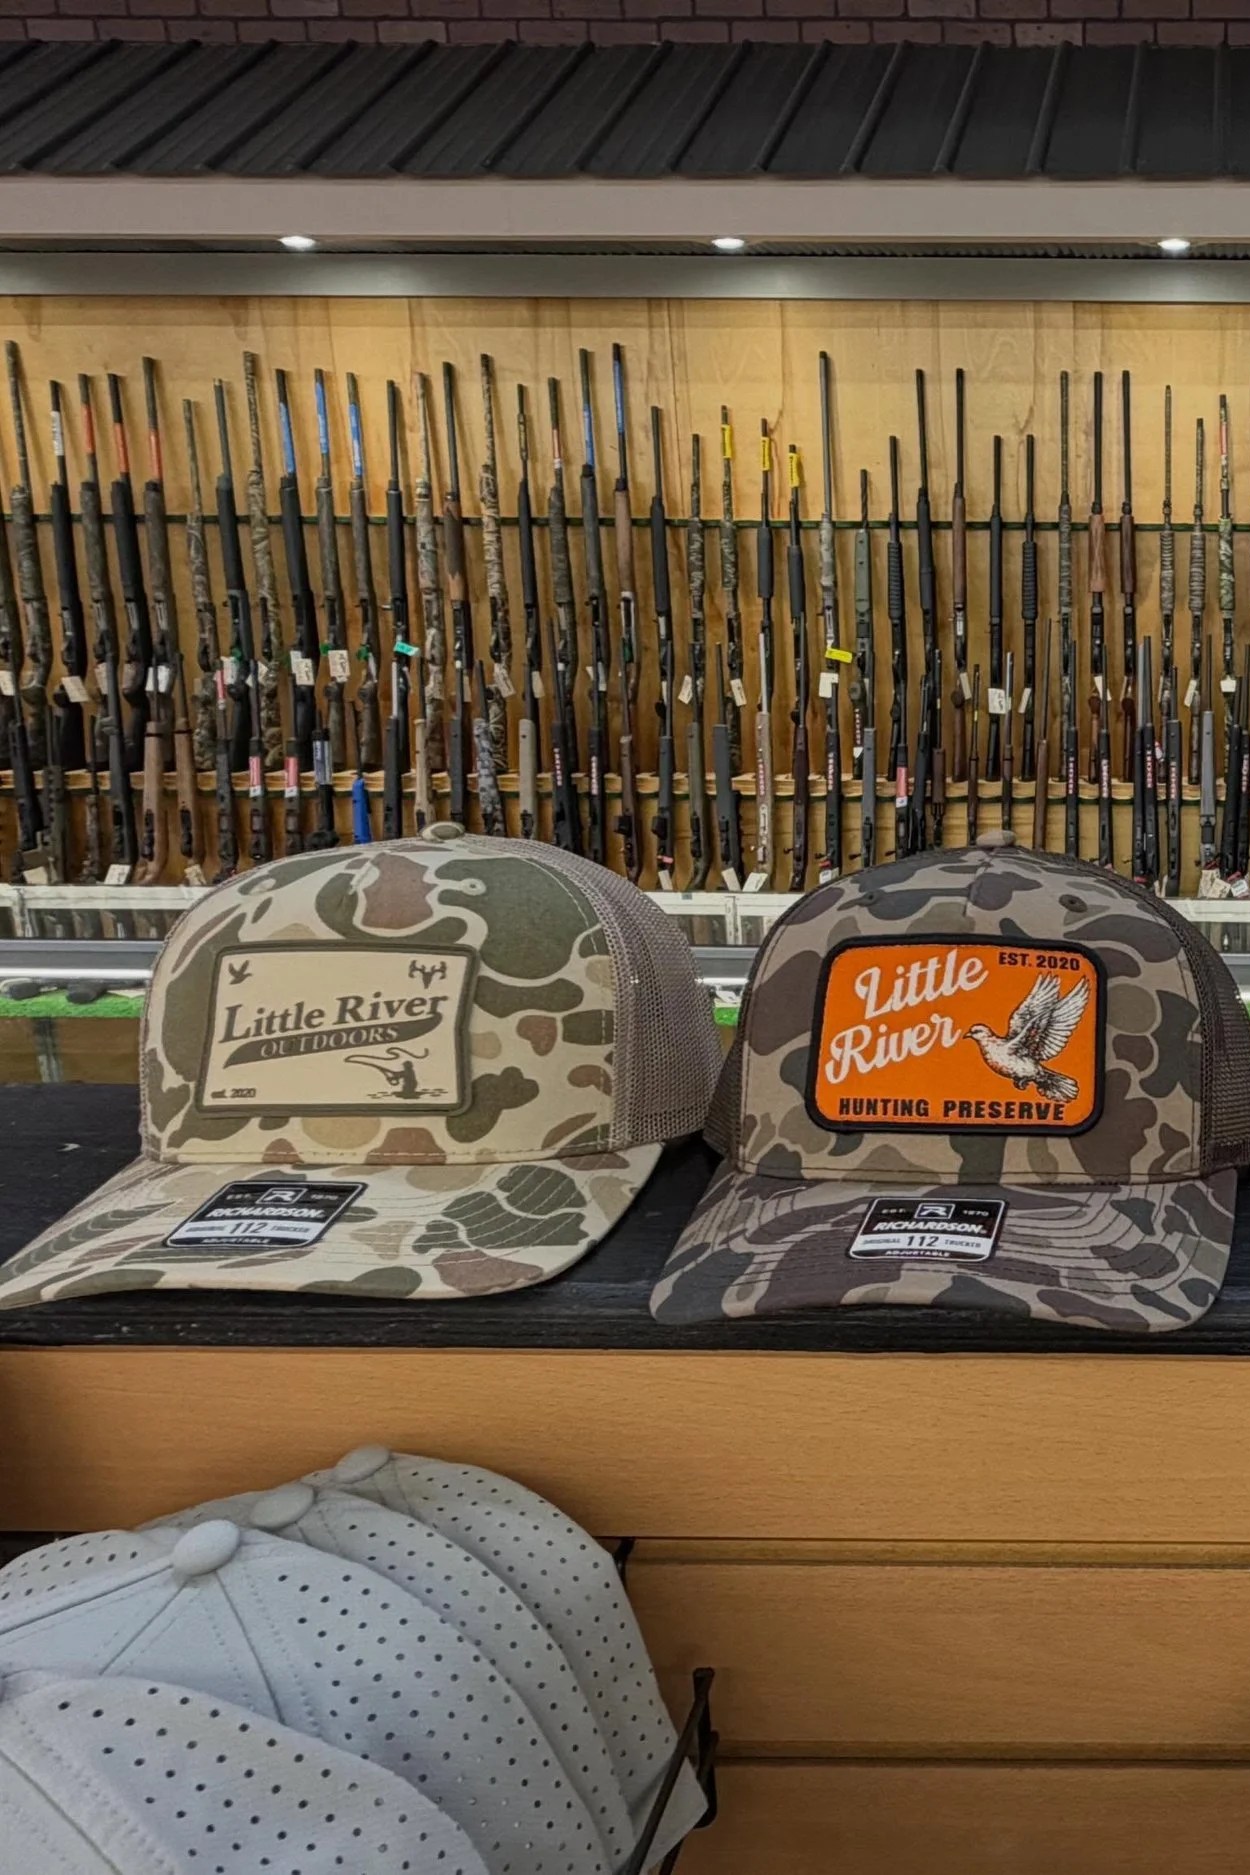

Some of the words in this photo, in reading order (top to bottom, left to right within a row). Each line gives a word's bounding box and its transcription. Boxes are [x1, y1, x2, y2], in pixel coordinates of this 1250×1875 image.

[998, 951, 1033, 968] EST.
[1036, 954, 1080, 971] 2020
[854, 948, 989, 1020] Little
[219, 1001, 325, 1044] Little
[333, 991, 449, 1025] River
[260, 1024, 399, 1058] OUTDOORS
[824, 1012, 962, 1085] River
[839, 1097, 930, 1118] HUNTING
[943, 1099, 1066, 1121] PRESERVE
[205, 1206, 324, 1218] RICHARDSON
[228, 1222, 269, 1234] 112
[873, 1221, 984, 1234] RICHARDSON
[906, 1235, 940, 1248] 112
